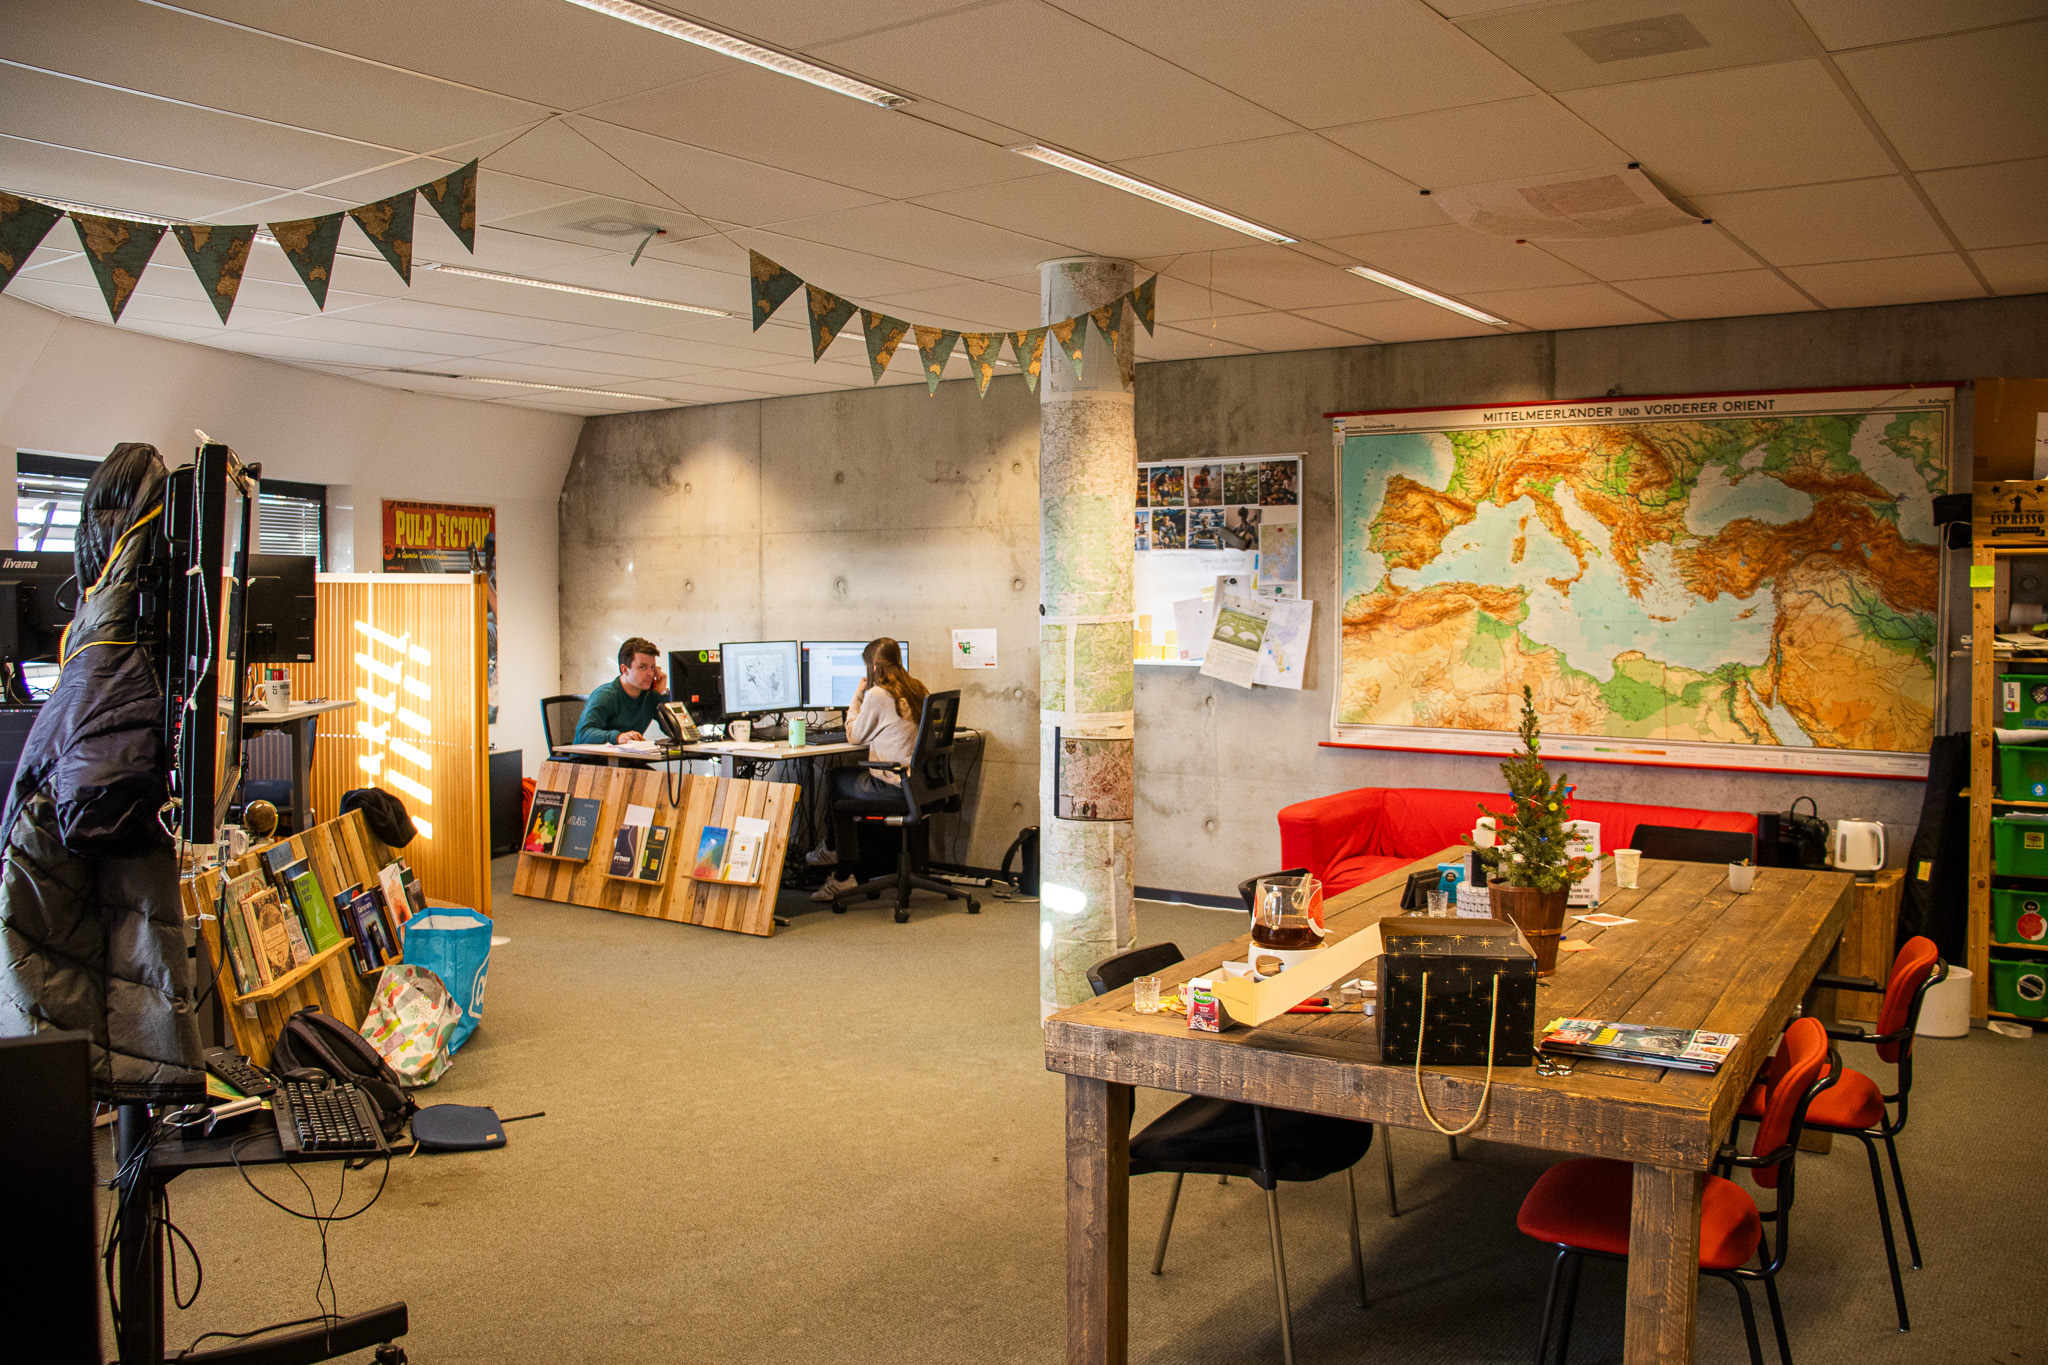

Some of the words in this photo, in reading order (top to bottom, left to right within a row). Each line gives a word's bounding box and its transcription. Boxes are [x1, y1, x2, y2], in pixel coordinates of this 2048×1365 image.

[1483, 406, 1613, 423] MITTELMEERLÄNDER
[1618, 406, 1640, 417] UND
[1645, 401, 1718, 416] VORDERER
[1722, 399, 1776, 413] ORIENT
[1991, 514, 2045, 525] ESPRESSO
[395, 511, 432, 546] PULP
[435, 513, 490, 549] FICTION
[2, 557, 38, 569] iiyama
